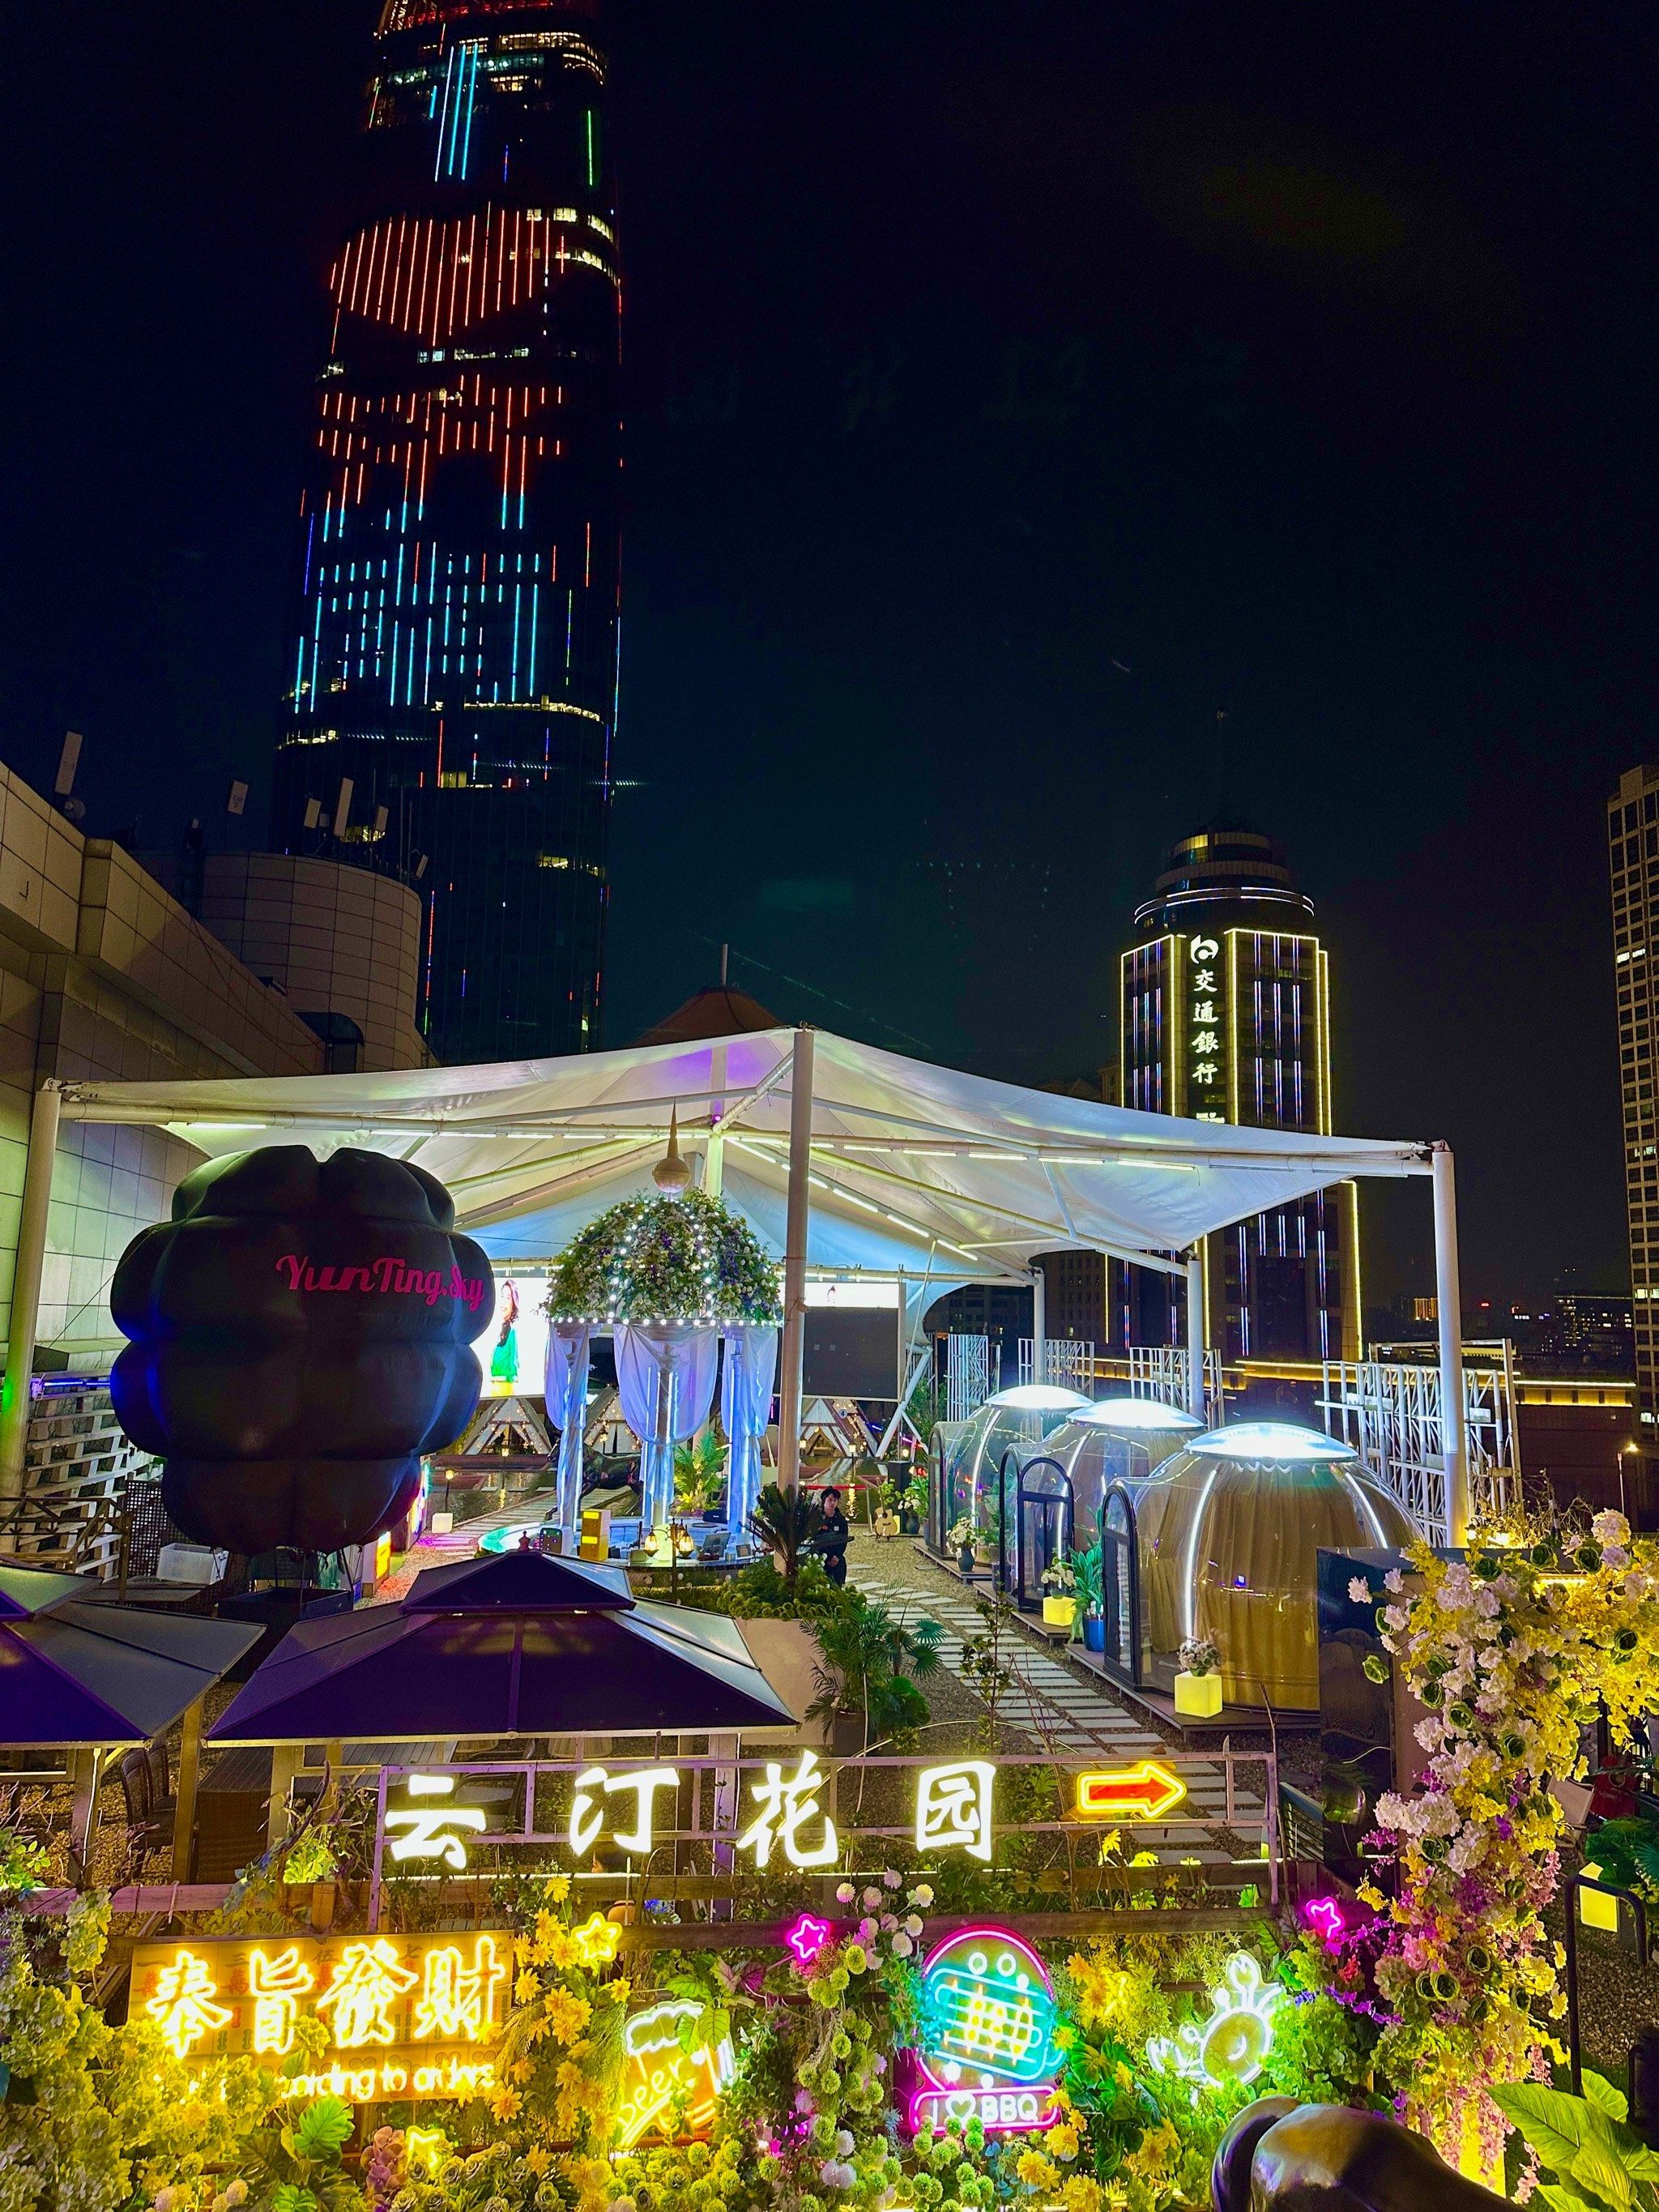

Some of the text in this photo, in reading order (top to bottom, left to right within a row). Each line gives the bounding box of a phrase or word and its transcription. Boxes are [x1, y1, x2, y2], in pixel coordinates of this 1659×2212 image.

[1191, 968, 1219, 1084] 交通銀行
[384, 1750, 997, 1868] 云汀花园
[380, 2063, 407, 2093] to
[981, 2093, 1038, 2124] BBQ
